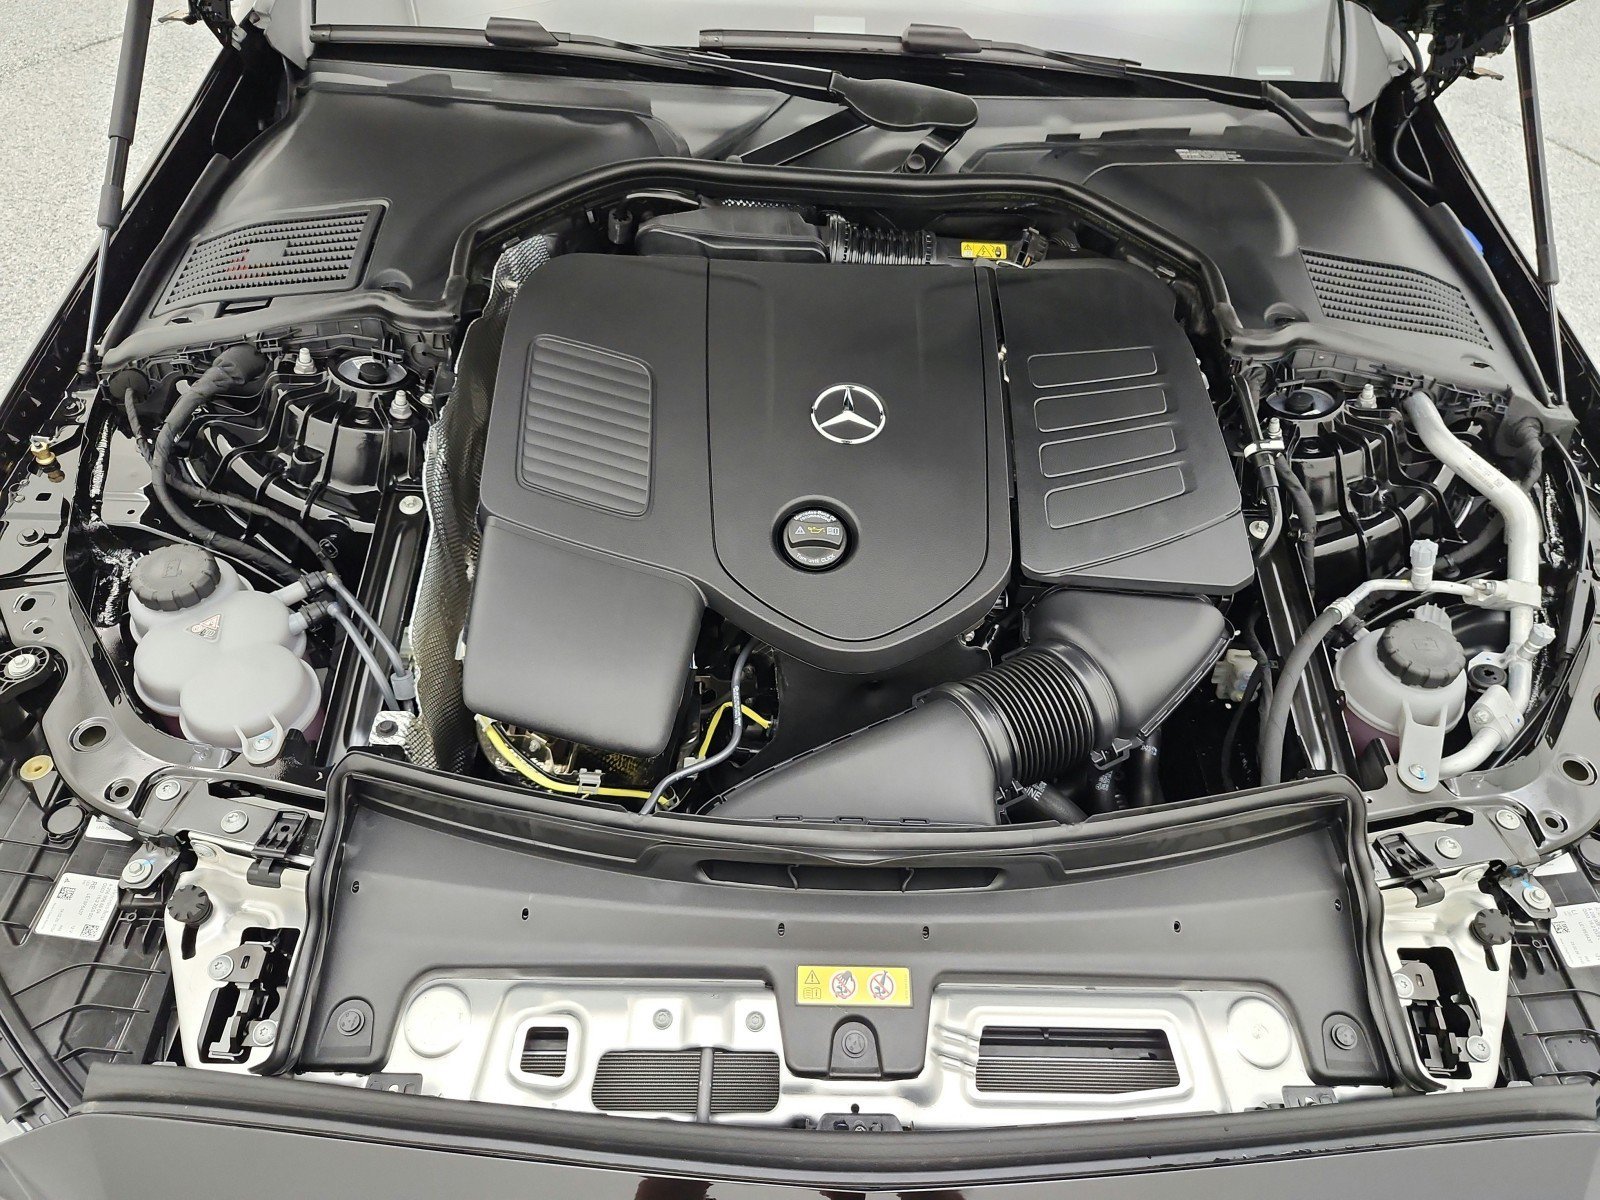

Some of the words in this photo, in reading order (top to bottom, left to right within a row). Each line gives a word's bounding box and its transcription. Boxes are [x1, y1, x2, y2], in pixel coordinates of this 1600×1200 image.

[793, 510, 830, 521] Mercedes-Benz
[800, 514, 831, 522] recommended
[796, 552, 807, 561] Turn
[820, 553, 835, 563] CLICK
